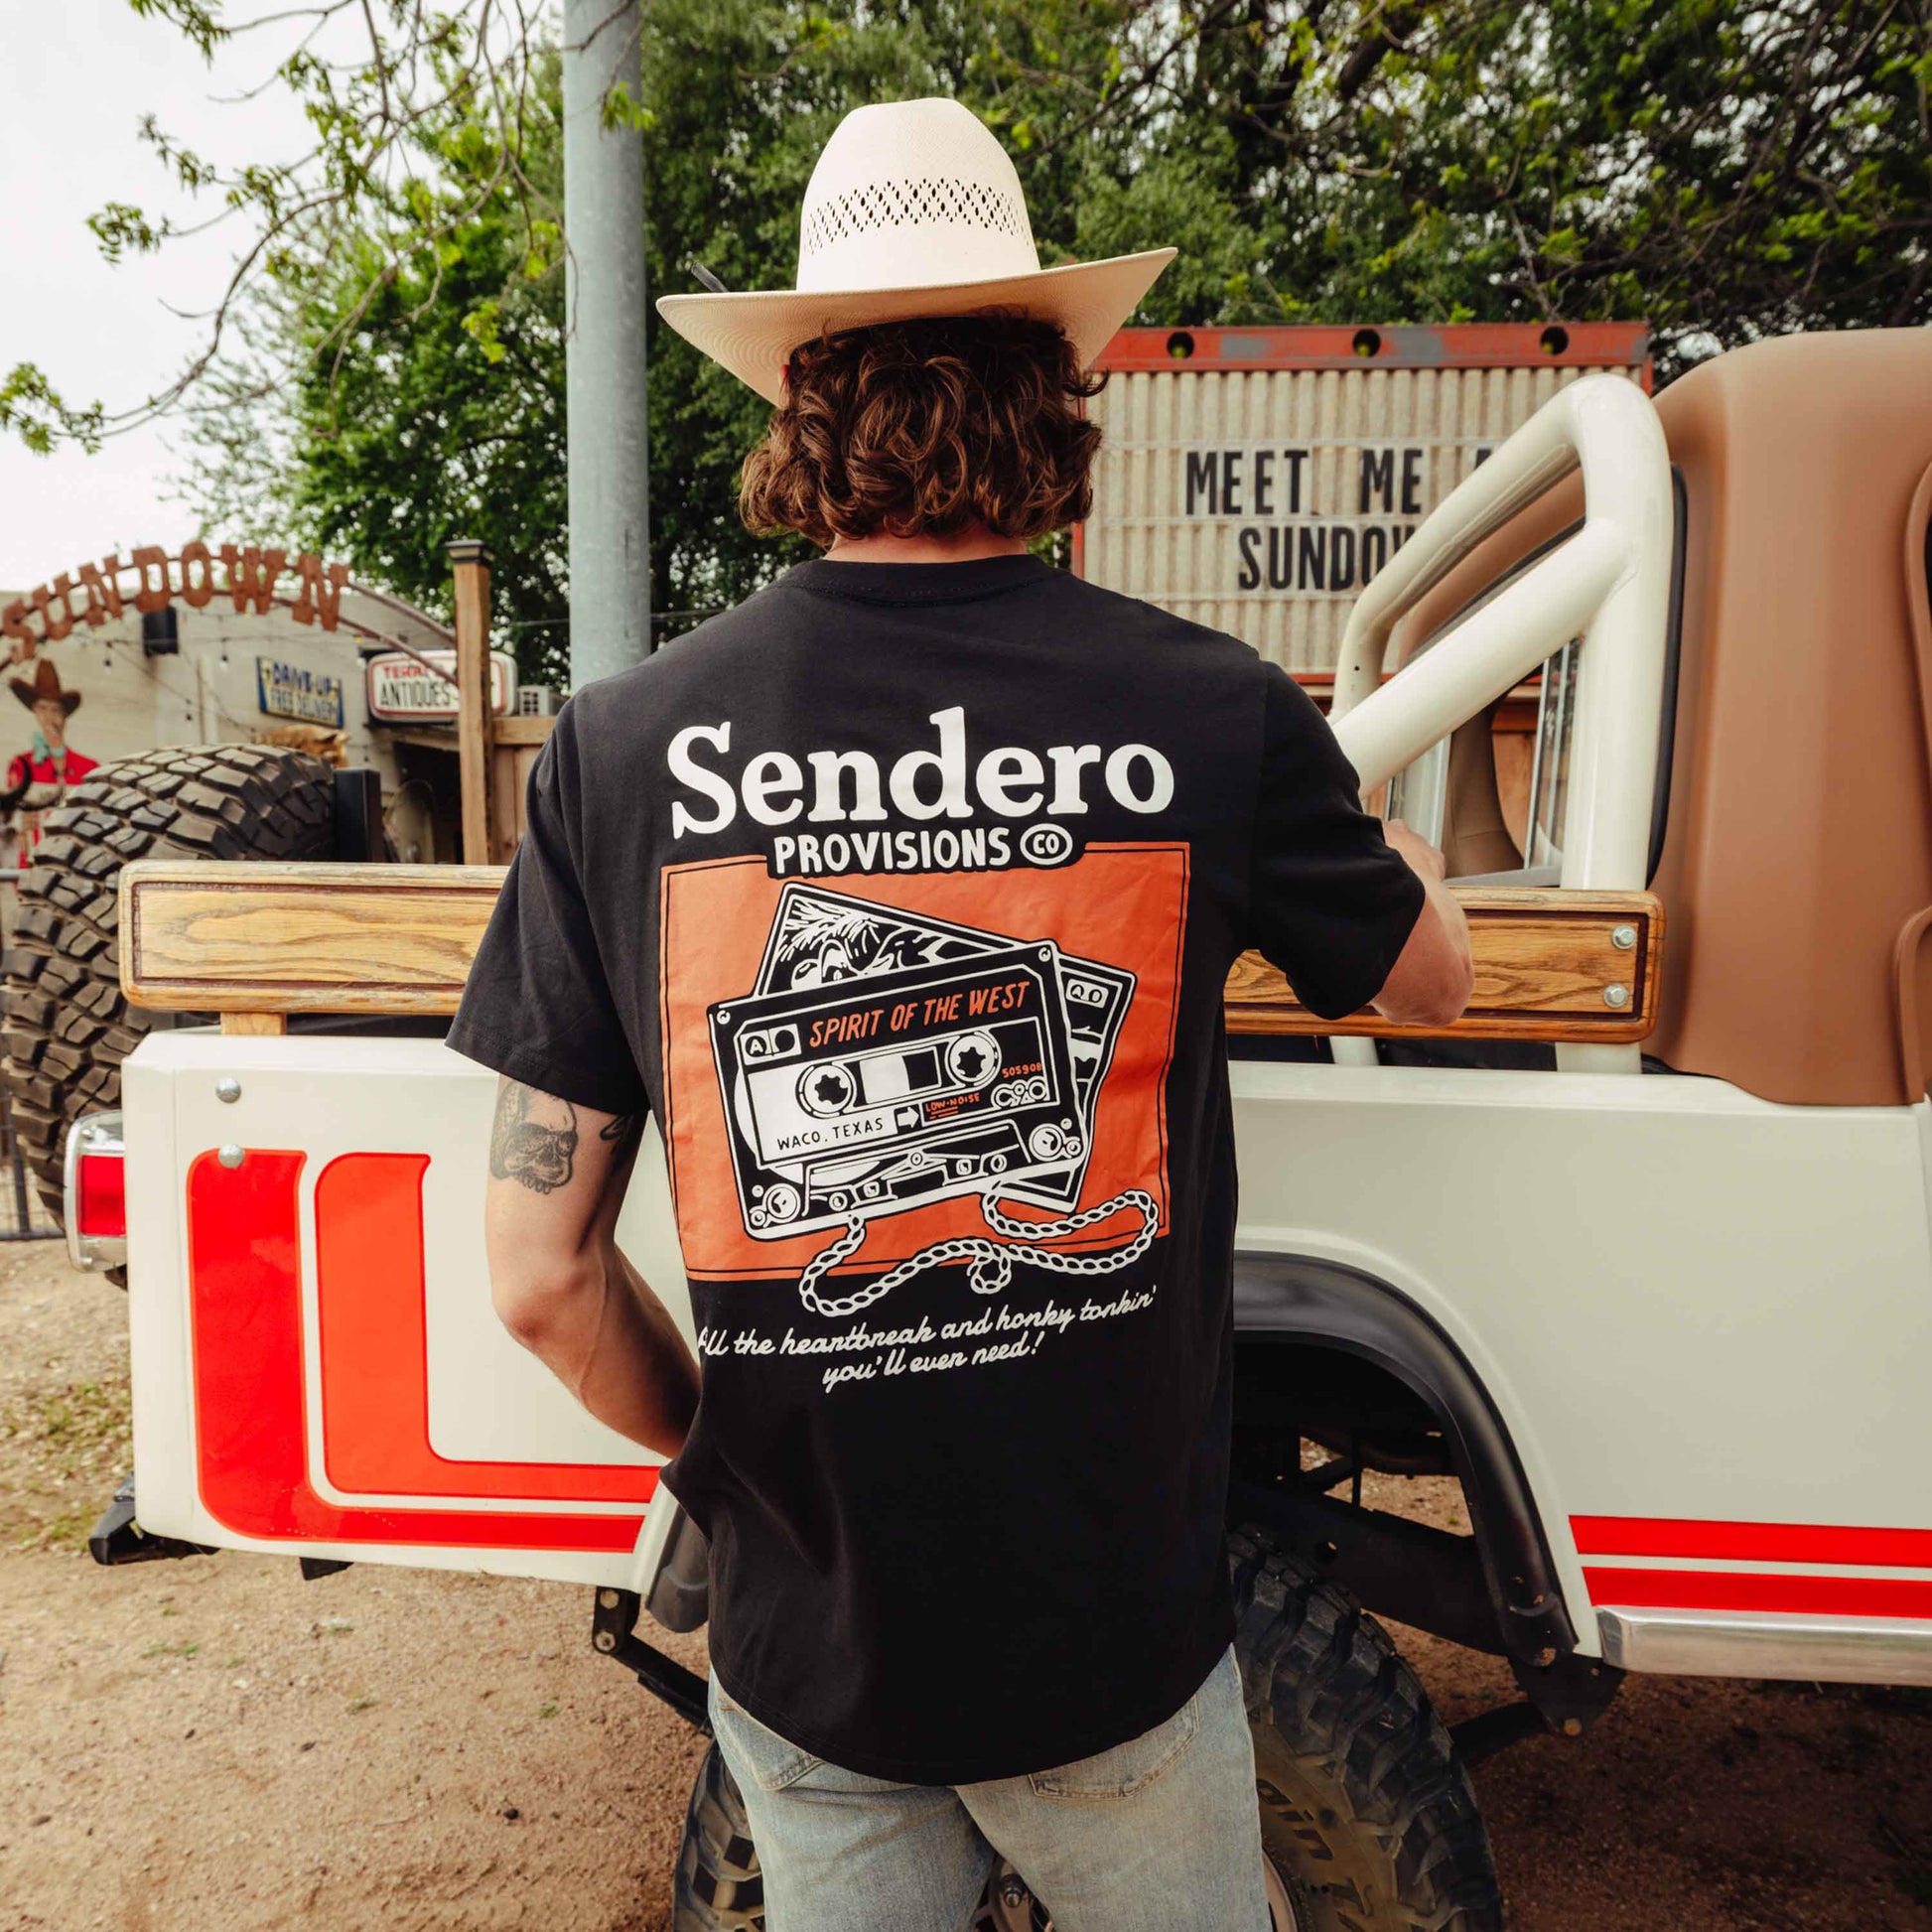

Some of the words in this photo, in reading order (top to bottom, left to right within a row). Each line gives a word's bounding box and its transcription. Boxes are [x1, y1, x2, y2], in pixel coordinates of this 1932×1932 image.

[1185, 449, 1309, 515] MEET
[1360, 448, 1423, 514] ME
[0, 541, 351, 665] SUNDOWN
[380, 679, 450, 707] ANTIQUES
[667, 706, 1174, 839] Sendero
[774, 827, 1011, 874] PROVISIONS
[1033, 833, 1060, 855] CO
[809, 1010, 885, 1047] SPIRIT
[891, 1003, 918, 1032] OF
[923, 994, 963, 1026] THE
[969, 981, 1031, 1017] WEST
[832, 1118, 883, 1139] TEXAS
[698, 1325, 729, 1355] All
[734, 1328, 775, 1354] the
[779, 1315, 937, 1355] heartbreak
[940, 1307, 994, 1337] and
[996, 1299, 1075, 1332] honky
[1079, 1285, 1156, 1320] tonkin'
[822, 1347, 906, 1393] you'll
[971, 1330, 1045, 1365] need!
